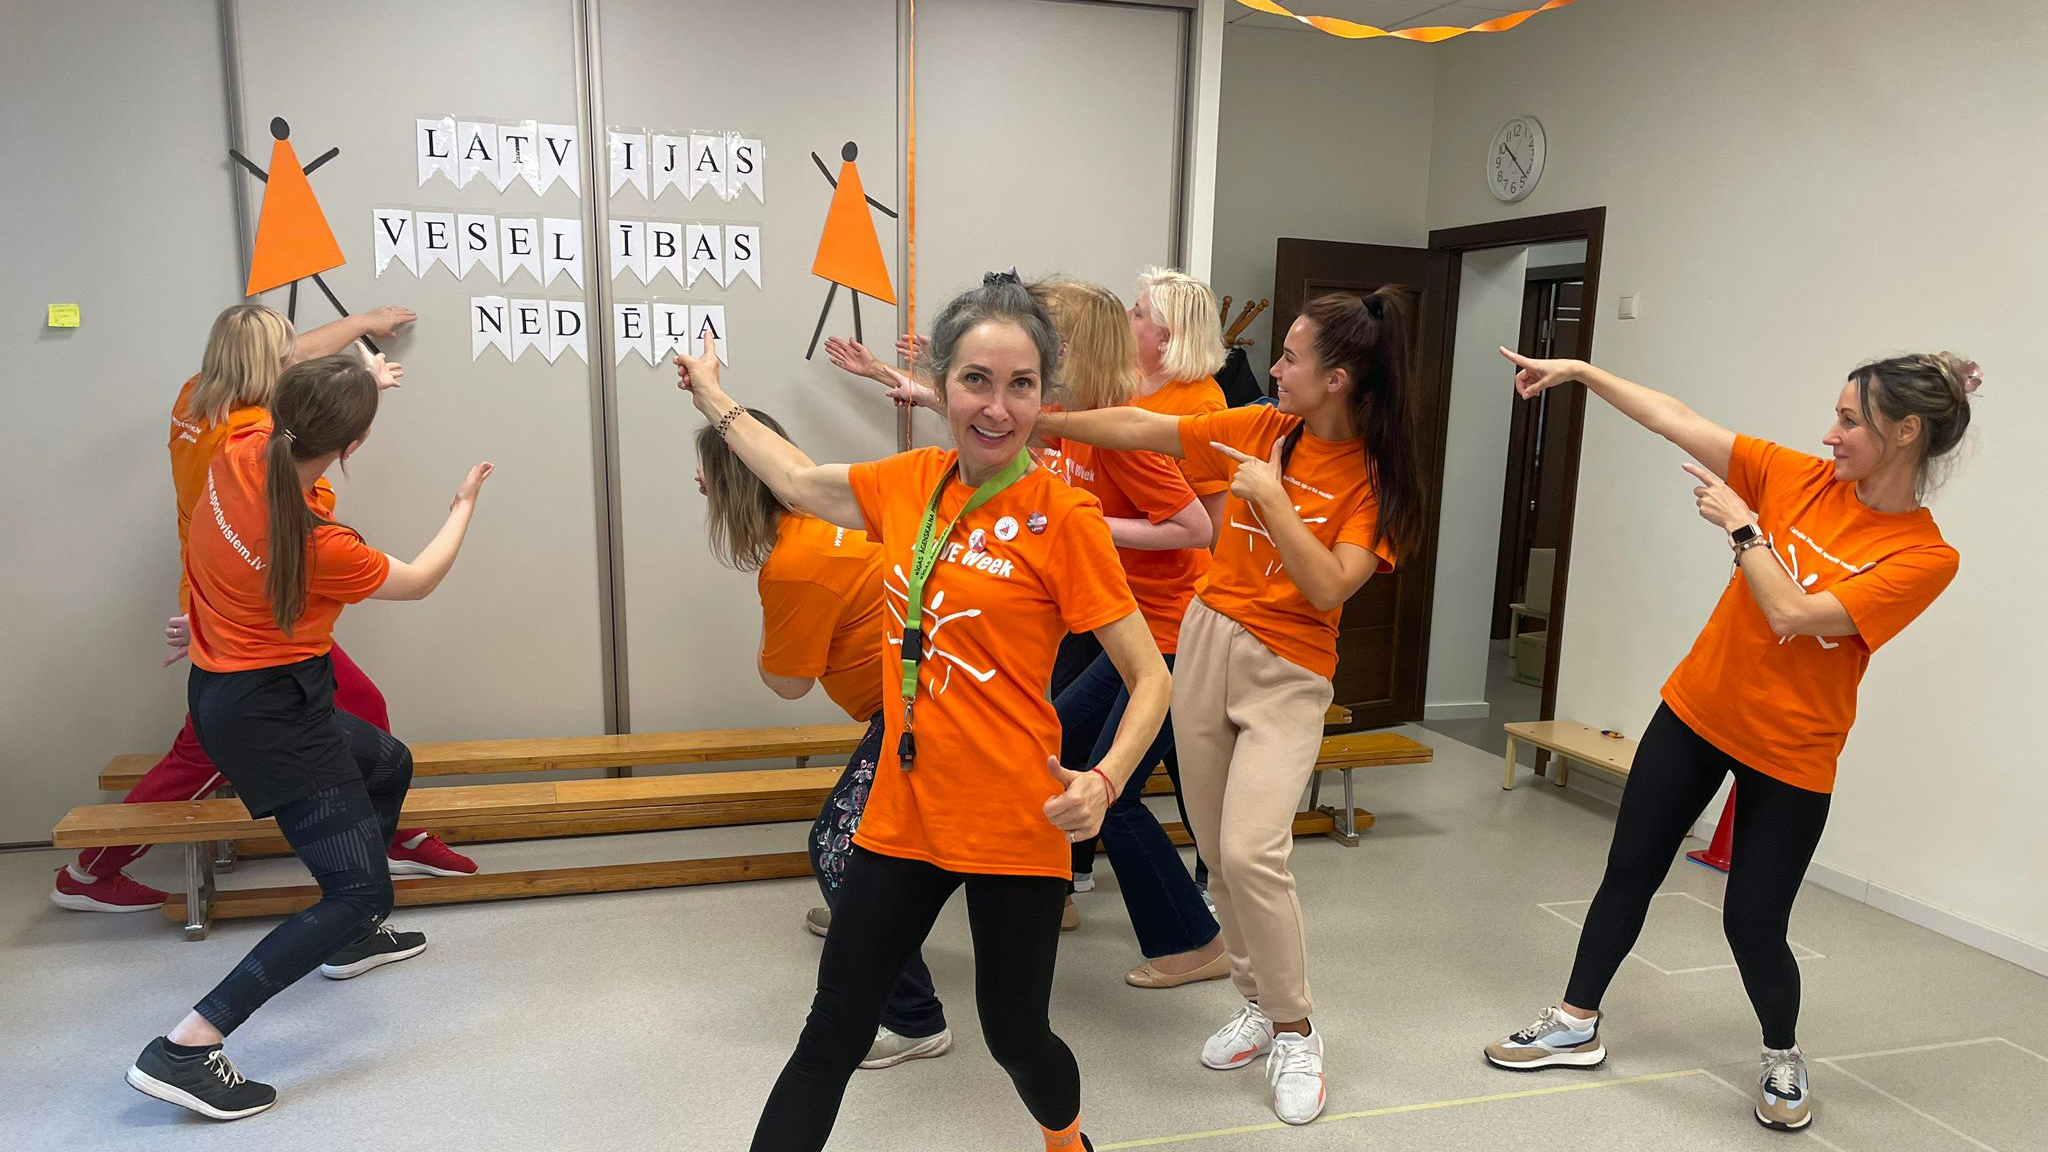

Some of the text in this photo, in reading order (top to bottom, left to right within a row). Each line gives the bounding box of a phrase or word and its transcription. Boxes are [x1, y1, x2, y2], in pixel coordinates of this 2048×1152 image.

[1506, 130, 1512, 142] 11
[1514, 124, 1521, 137] 12
[1499, 142, 1506, 155] 10
[1495, 156, 1501, 169] 9
[1497, 170, 1503, 182] 8
[1503, 179, 1508, 191] 7
[1510, 181, 1516, 193] 6
[961, 549, 1015, 578] Week
